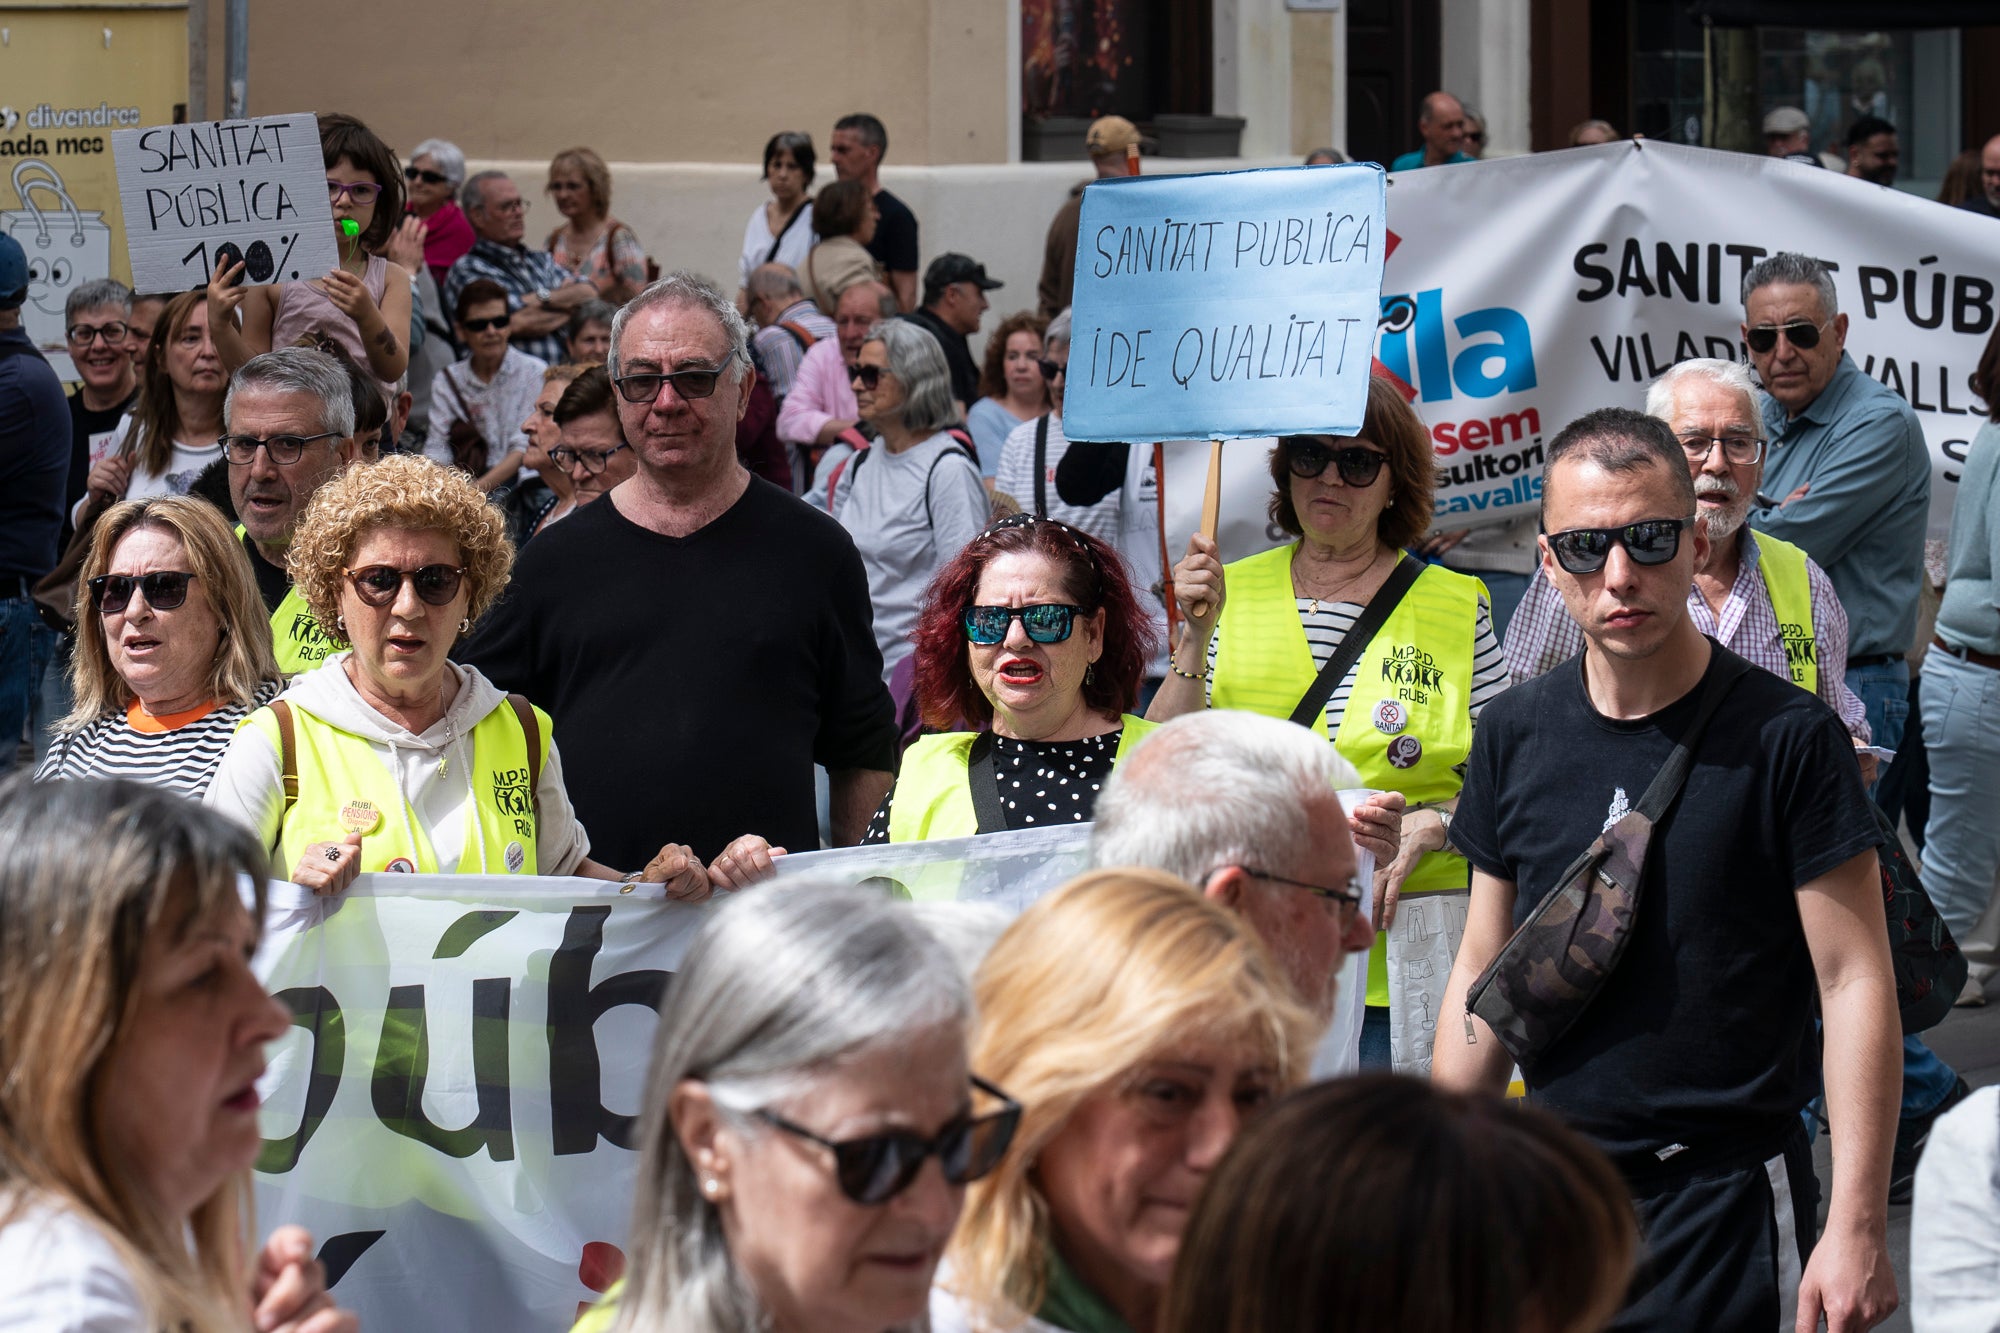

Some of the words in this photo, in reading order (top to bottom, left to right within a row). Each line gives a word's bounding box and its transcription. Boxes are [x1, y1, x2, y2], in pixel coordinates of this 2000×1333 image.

[27, 102, 140, 128] divendres
[56, 137, 104, 155] mes
[139, 122, 290, 173] SANITAT
[147, 180, 298, 230] PÚBLICA
[182, 233, 299, 290] 100%
[1095, 218, 1223, 278] SANITAT
[1236, 212, 1370, 268] PUBLICA
[1173, 314, 1361, 390] QUALITAT
[1375, 720, 1405, 732] SANITAT
[342, 806, 378, 820] PENSIONS
